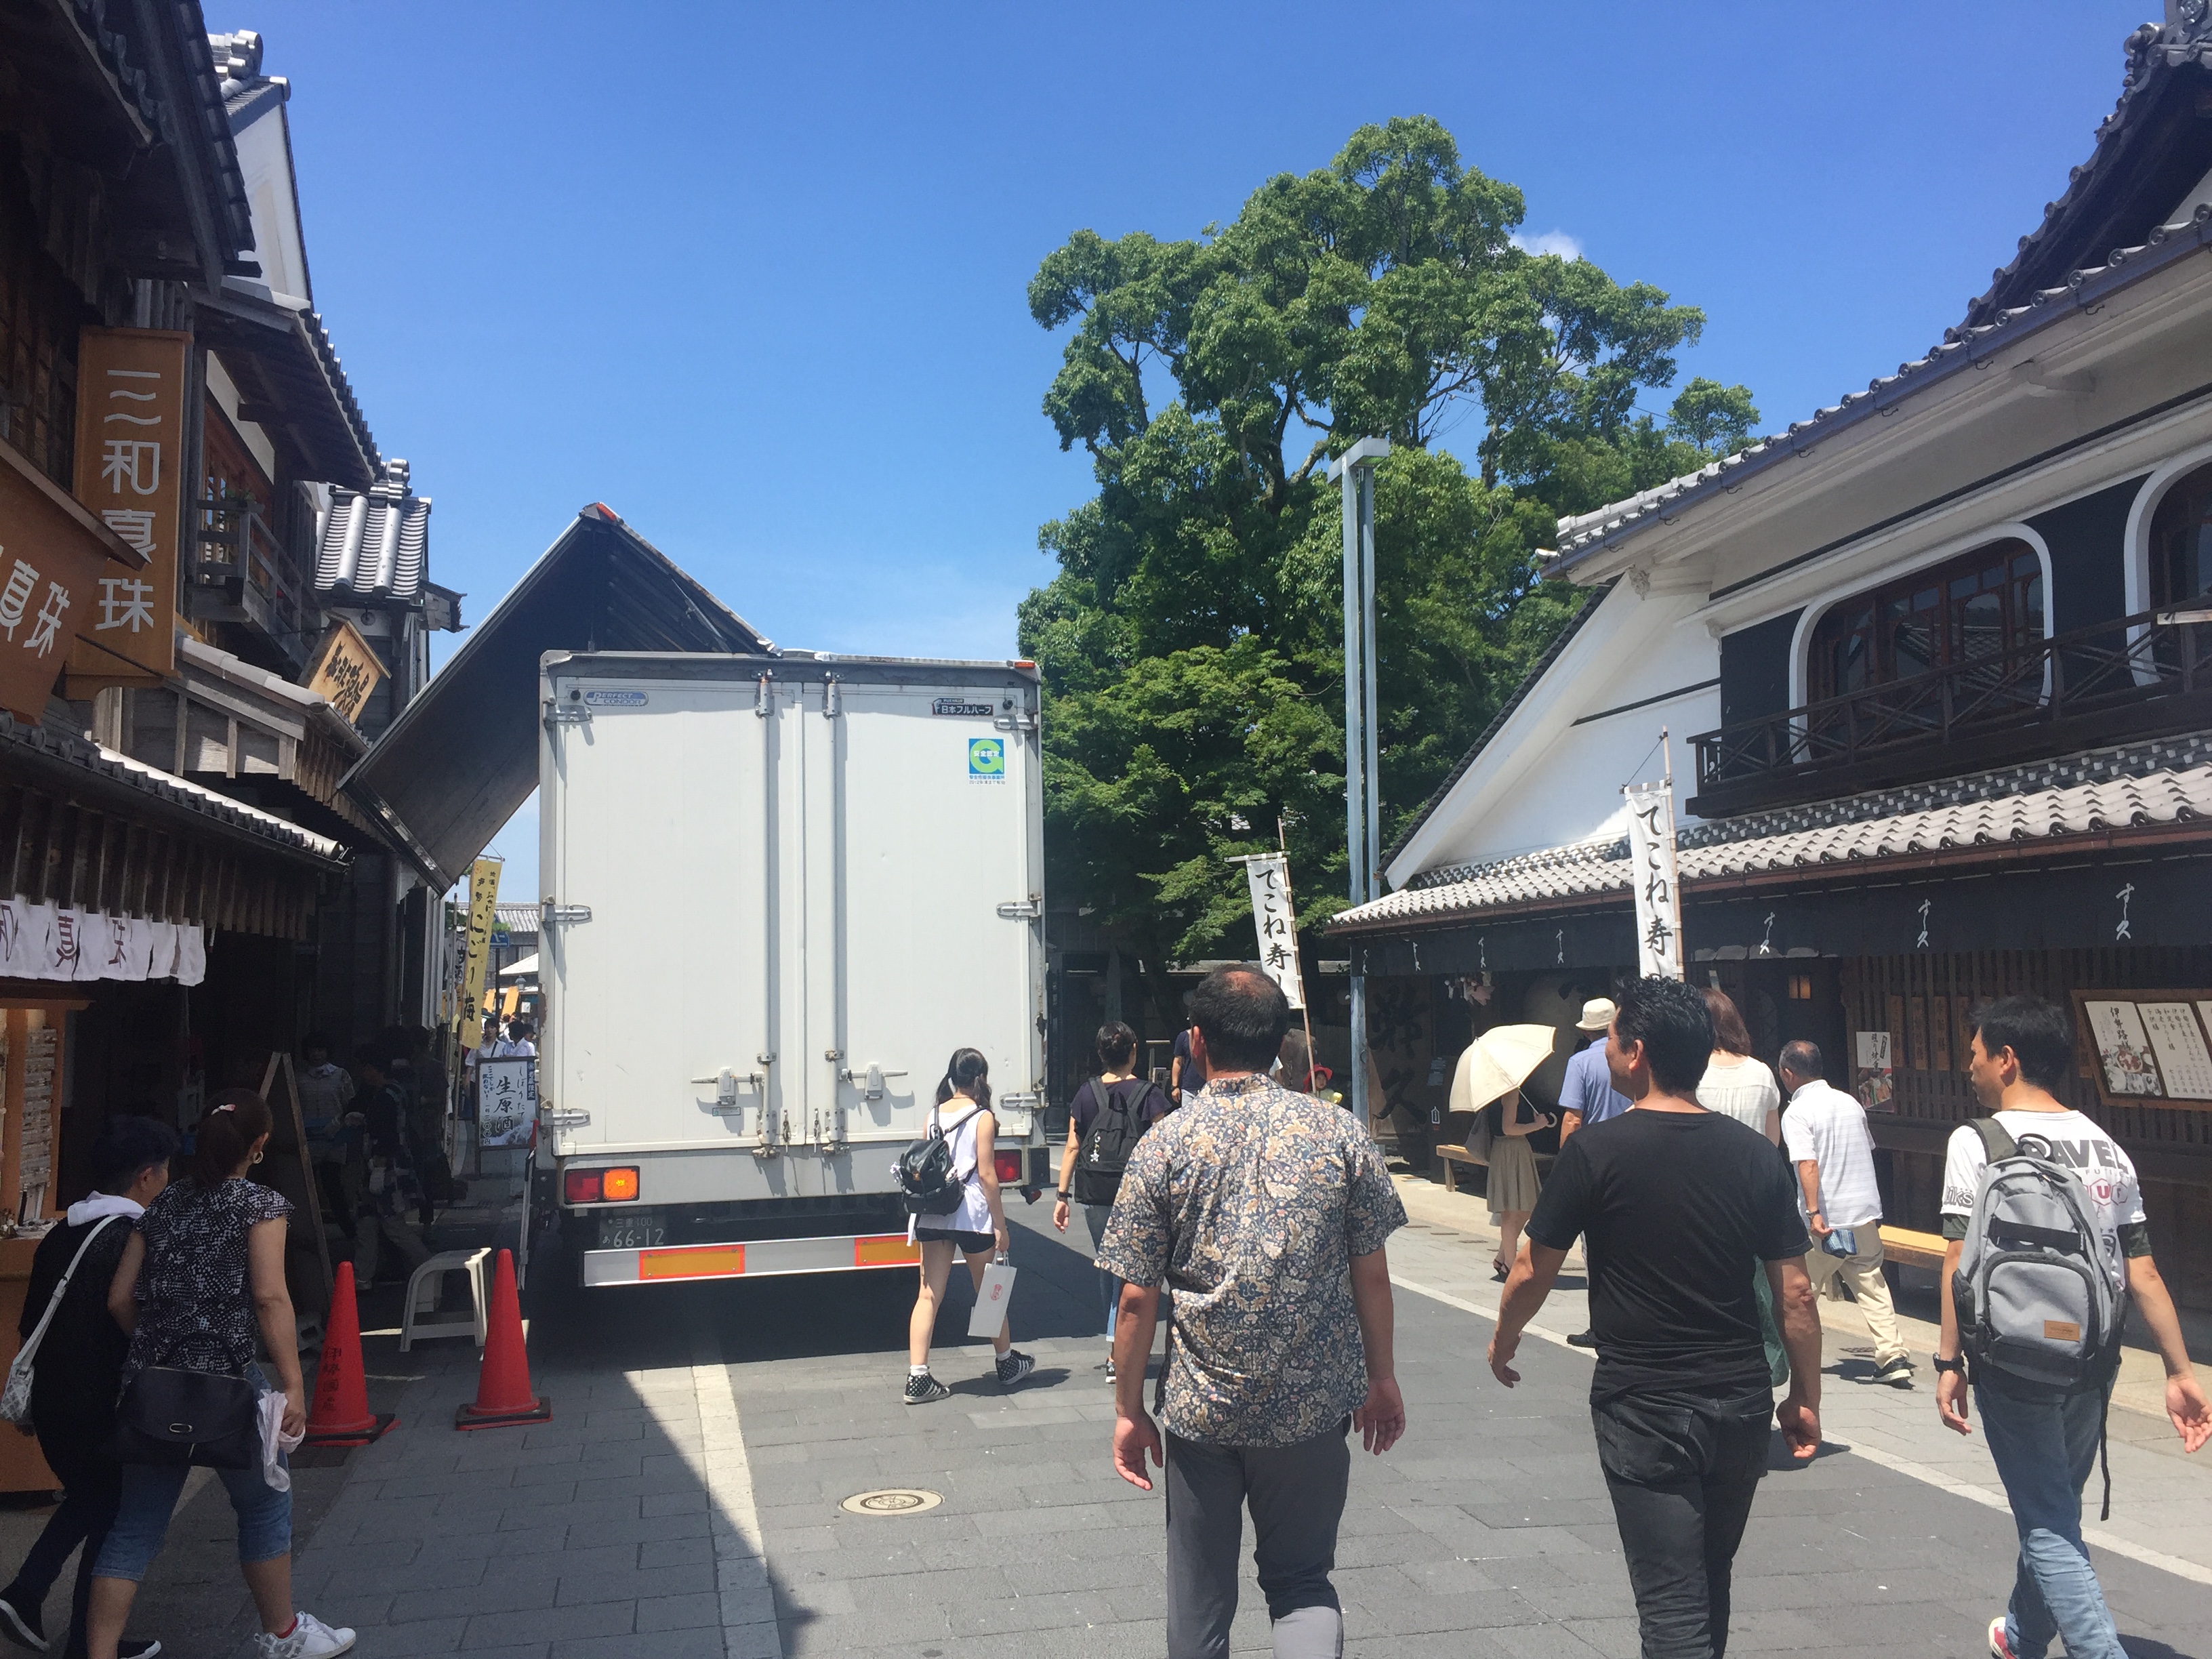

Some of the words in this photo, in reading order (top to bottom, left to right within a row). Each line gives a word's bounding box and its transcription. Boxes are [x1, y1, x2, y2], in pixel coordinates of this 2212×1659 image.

[95, 369, 161, 633] 三和真珠
[0, 545, 70, 658] 真珠
[594, 692, 633, 702] PERFECT
[941, 705, 991, 714] 日本フルハーフ
[493, 1076, 516, 1133] 生原酒
[613, 1228, 664, 1248] 66-12
